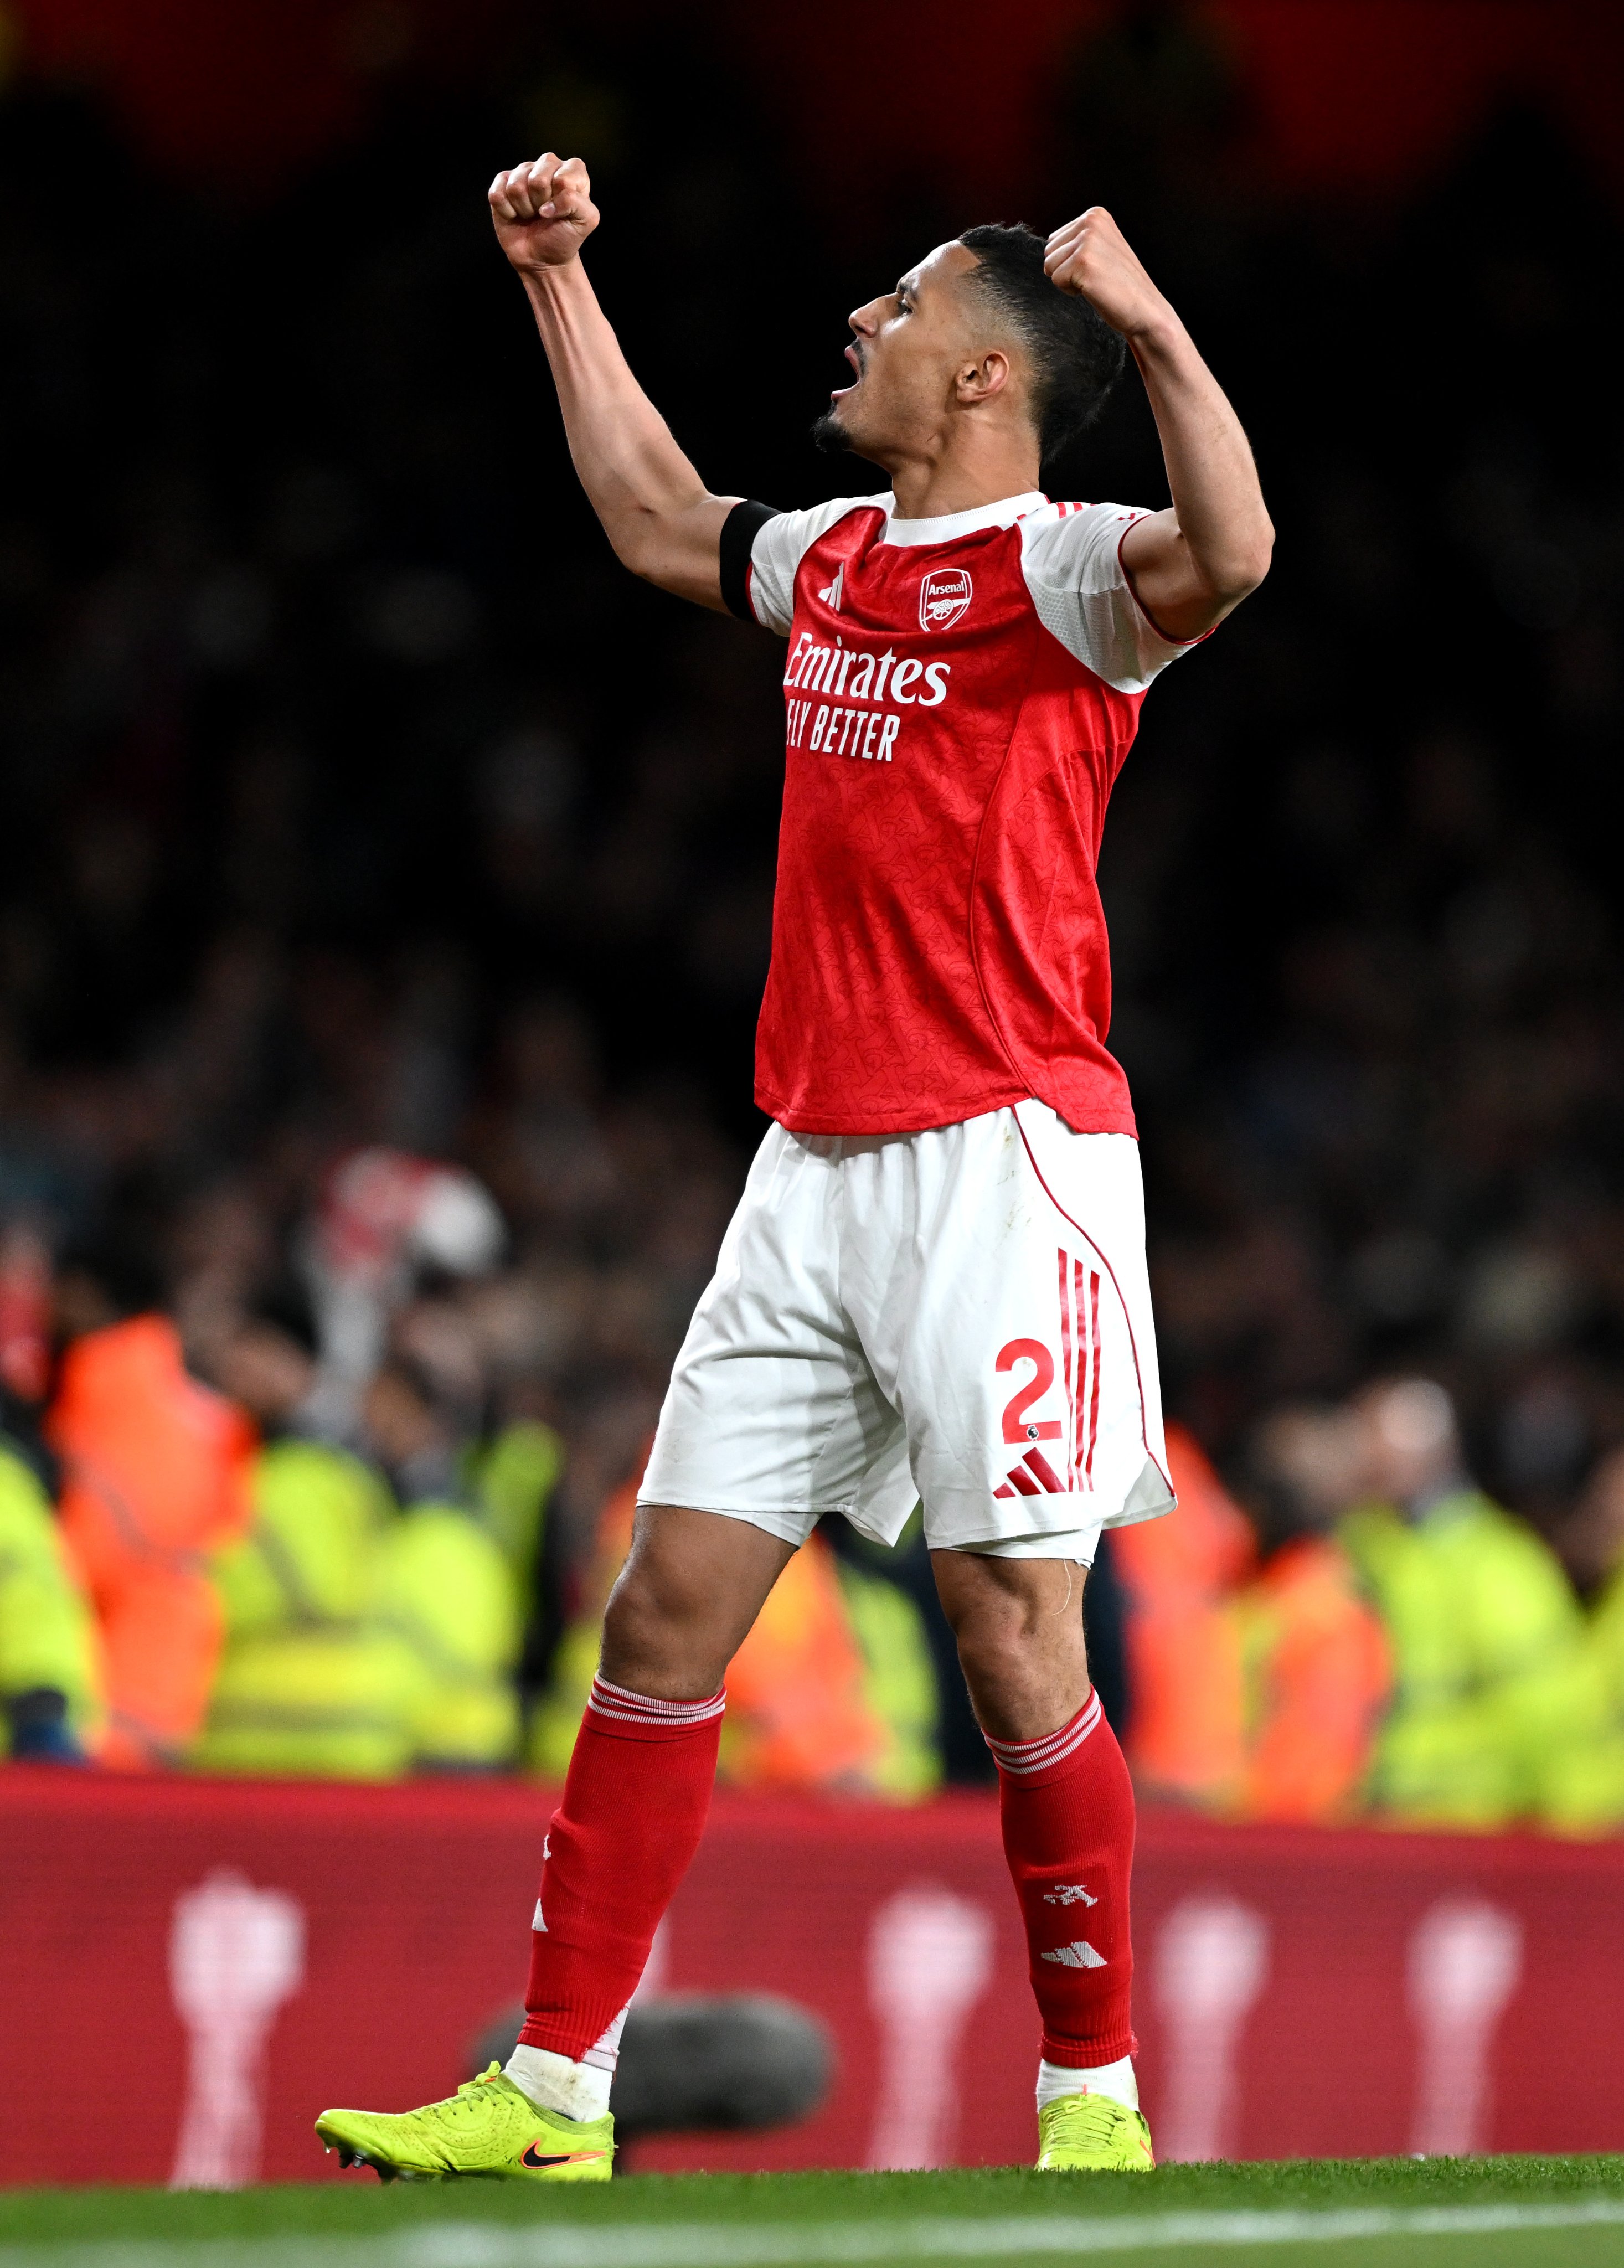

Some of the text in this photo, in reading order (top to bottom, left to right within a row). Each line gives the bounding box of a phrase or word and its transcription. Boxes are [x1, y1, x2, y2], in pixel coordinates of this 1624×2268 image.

[928, 580, 965, 596] Arsenal
[783, 632, 951, 707] Emirates
[786, 699, 900, 761] FLY BETTER
[995, 1338, 1063, 1444] 2
